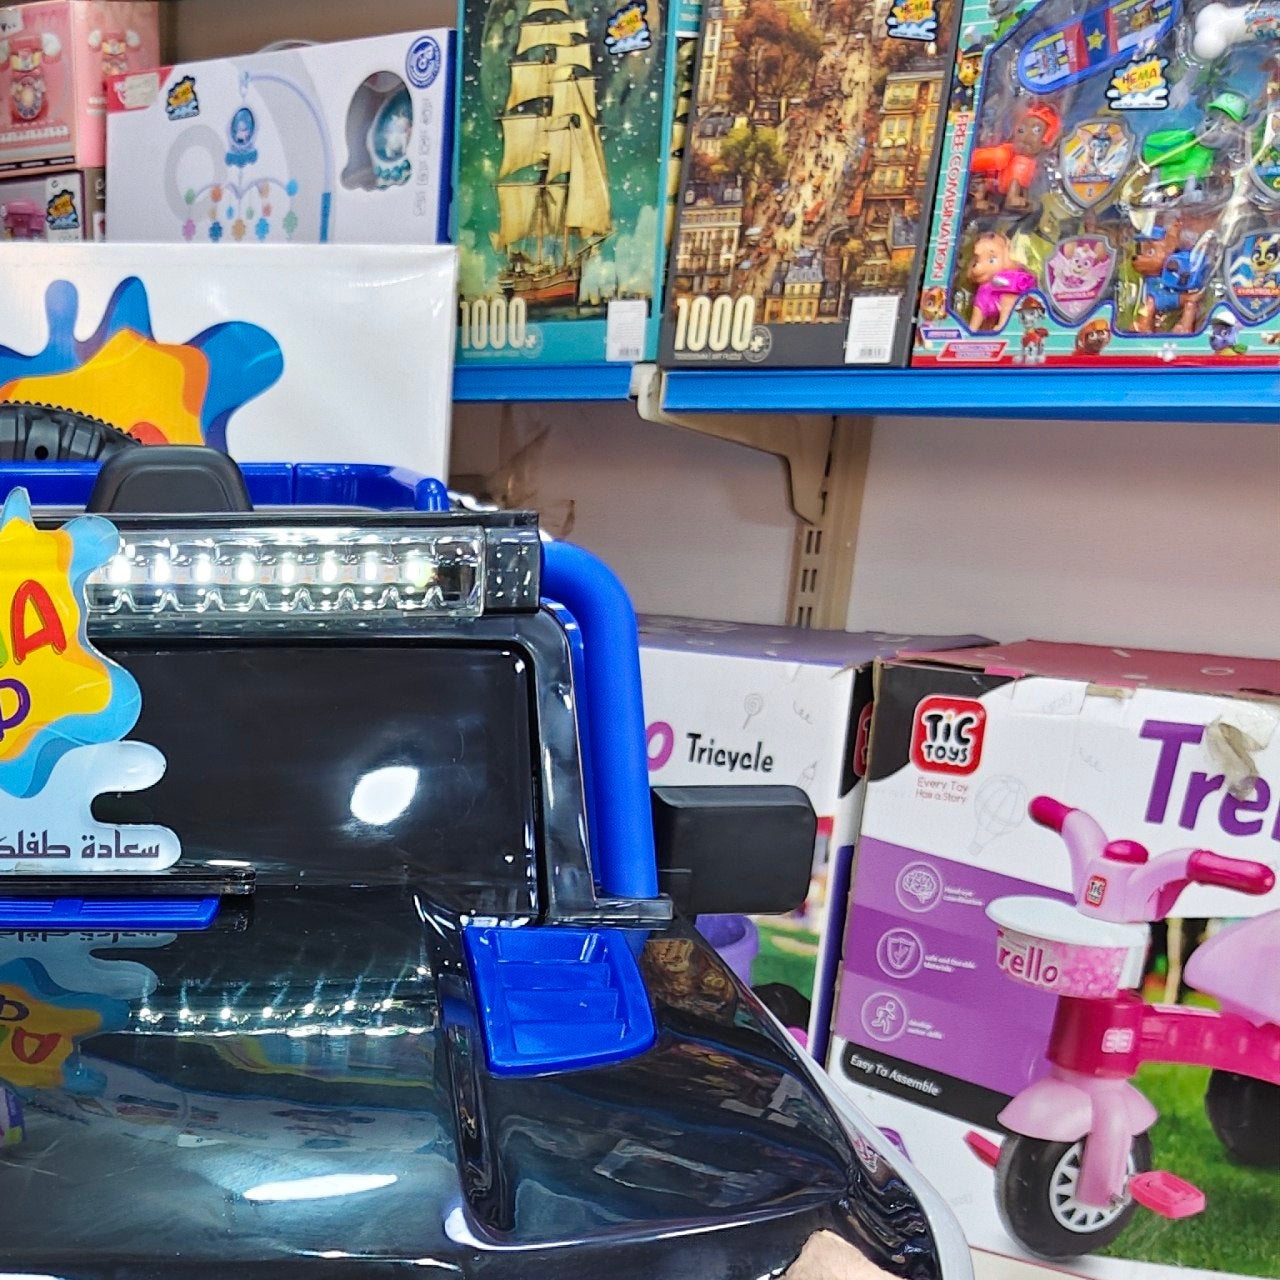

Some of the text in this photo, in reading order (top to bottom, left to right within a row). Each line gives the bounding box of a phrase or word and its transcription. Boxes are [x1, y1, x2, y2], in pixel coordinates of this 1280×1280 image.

[460, 297, 527, 350] 1000
[674, 295, 755, 352] 1000
[686, 732, 774, 773] Tricycle
[1139, 719, 1280, 842] Tre
[81, 829, 160, 859] سعادة
[849, 1053, 942, 1097] Easy To Assemble
